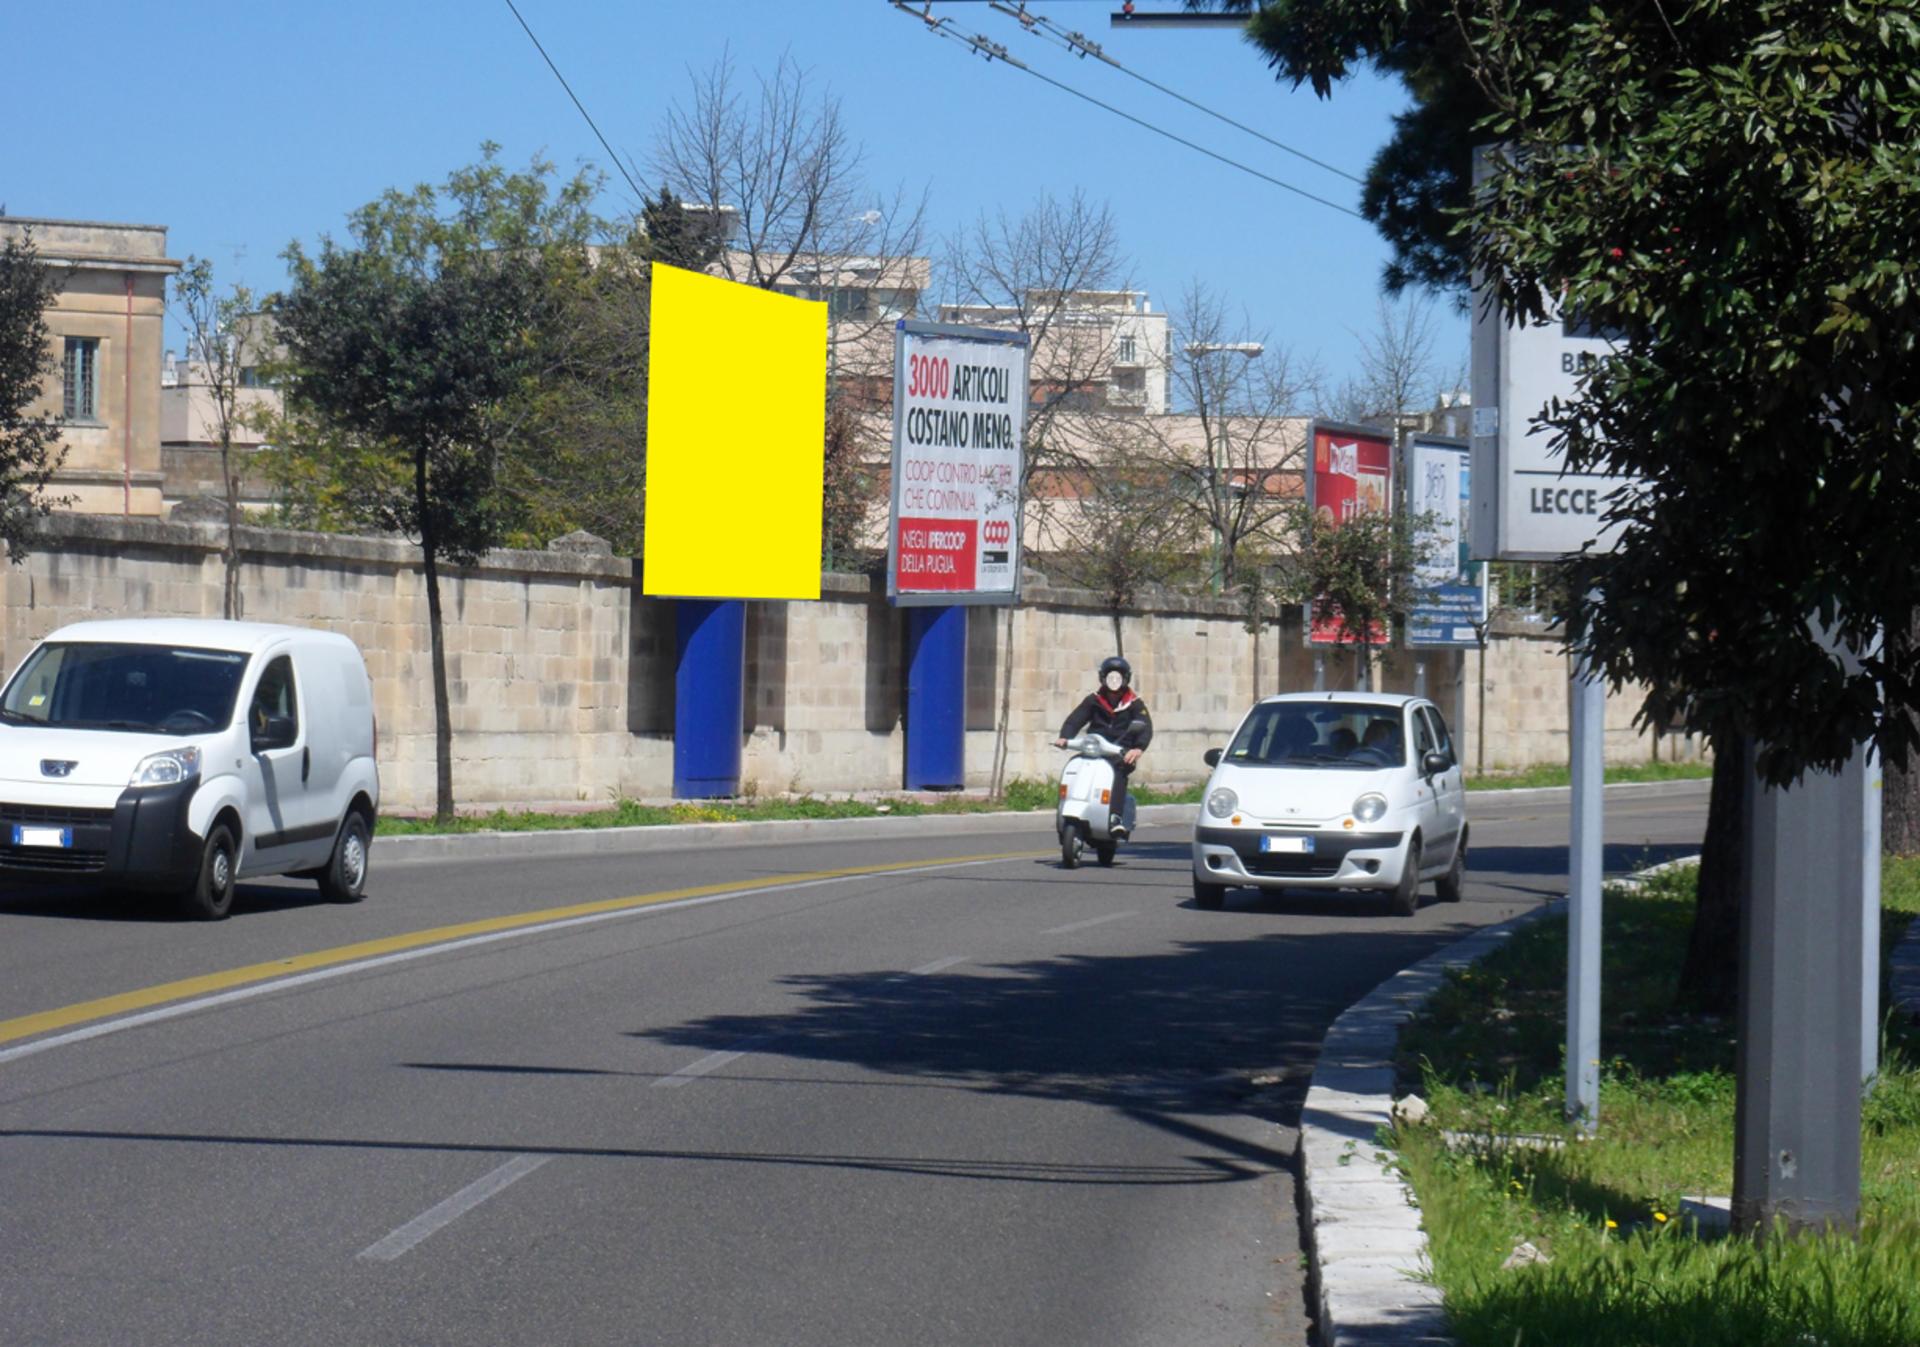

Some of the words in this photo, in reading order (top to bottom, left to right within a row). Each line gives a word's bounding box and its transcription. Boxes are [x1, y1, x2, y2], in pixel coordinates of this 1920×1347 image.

[908, 353, 949, 399] 3000
[952, 364, 1009, 404] ARTICOLI
[907, 407, 969, 448] COSTANO
[972, 412, 1015, 450] MENO.
[905, 459, 935, 482] COOP
[937, 461, 976, 484] CONTRO
[904, 487, 924, 509] CHE
[1531, 488, 1597, 514] LECCE
[928, 530, 967, 550] IPERCOOP
[901, 553, 925, 573] DELLA
